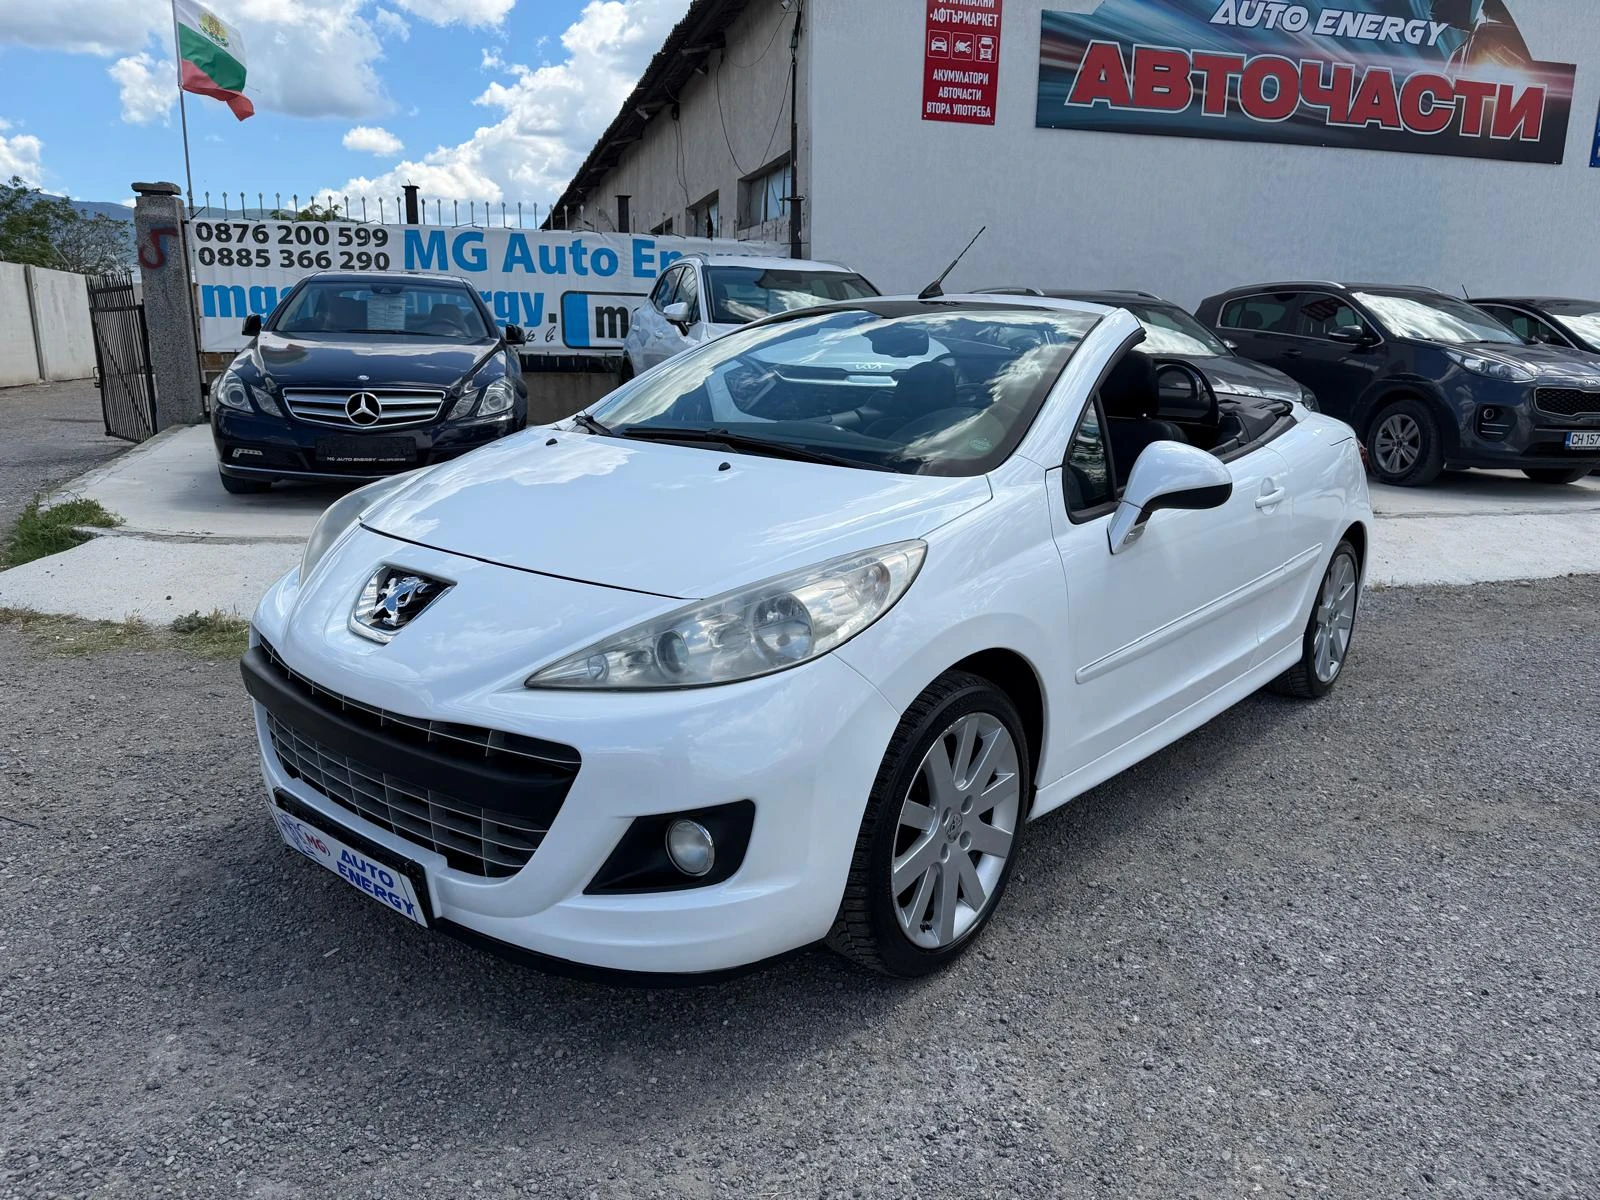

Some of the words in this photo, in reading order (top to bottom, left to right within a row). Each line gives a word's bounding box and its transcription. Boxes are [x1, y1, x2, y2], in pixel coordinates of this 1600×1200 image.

[1209, 0, 1309, 33] AUTO
[1312, 9, 1449, 46] ENERGY
[932, 68, 989, 85] АКУМУЛАТОРИ
[937, 86, 982, 101] АВТОЧАСТИ
[1065, 39, 1547, 142] АВТОЧАСТИ
[926, 101, 951, 115] ВТОРА
[952, 104, 991, 118] УПОТРЕБА
[195, 222, 270, 244] 0876
[277, 225, 330, 246] 200
[338, 227, 389, 248] 599
[199, 246, 271, 268] 0885
[279, 249, 332, 269] 366
[339, 250, 390, 271] 290
[403, 229, 488, 272] MG
[501, 232, 619, 277] Auto
[1571, 433, 1585, 446] CH
[341, 849, 394, 889] AUTO
[336, 861, 414, 916] ENERGY
